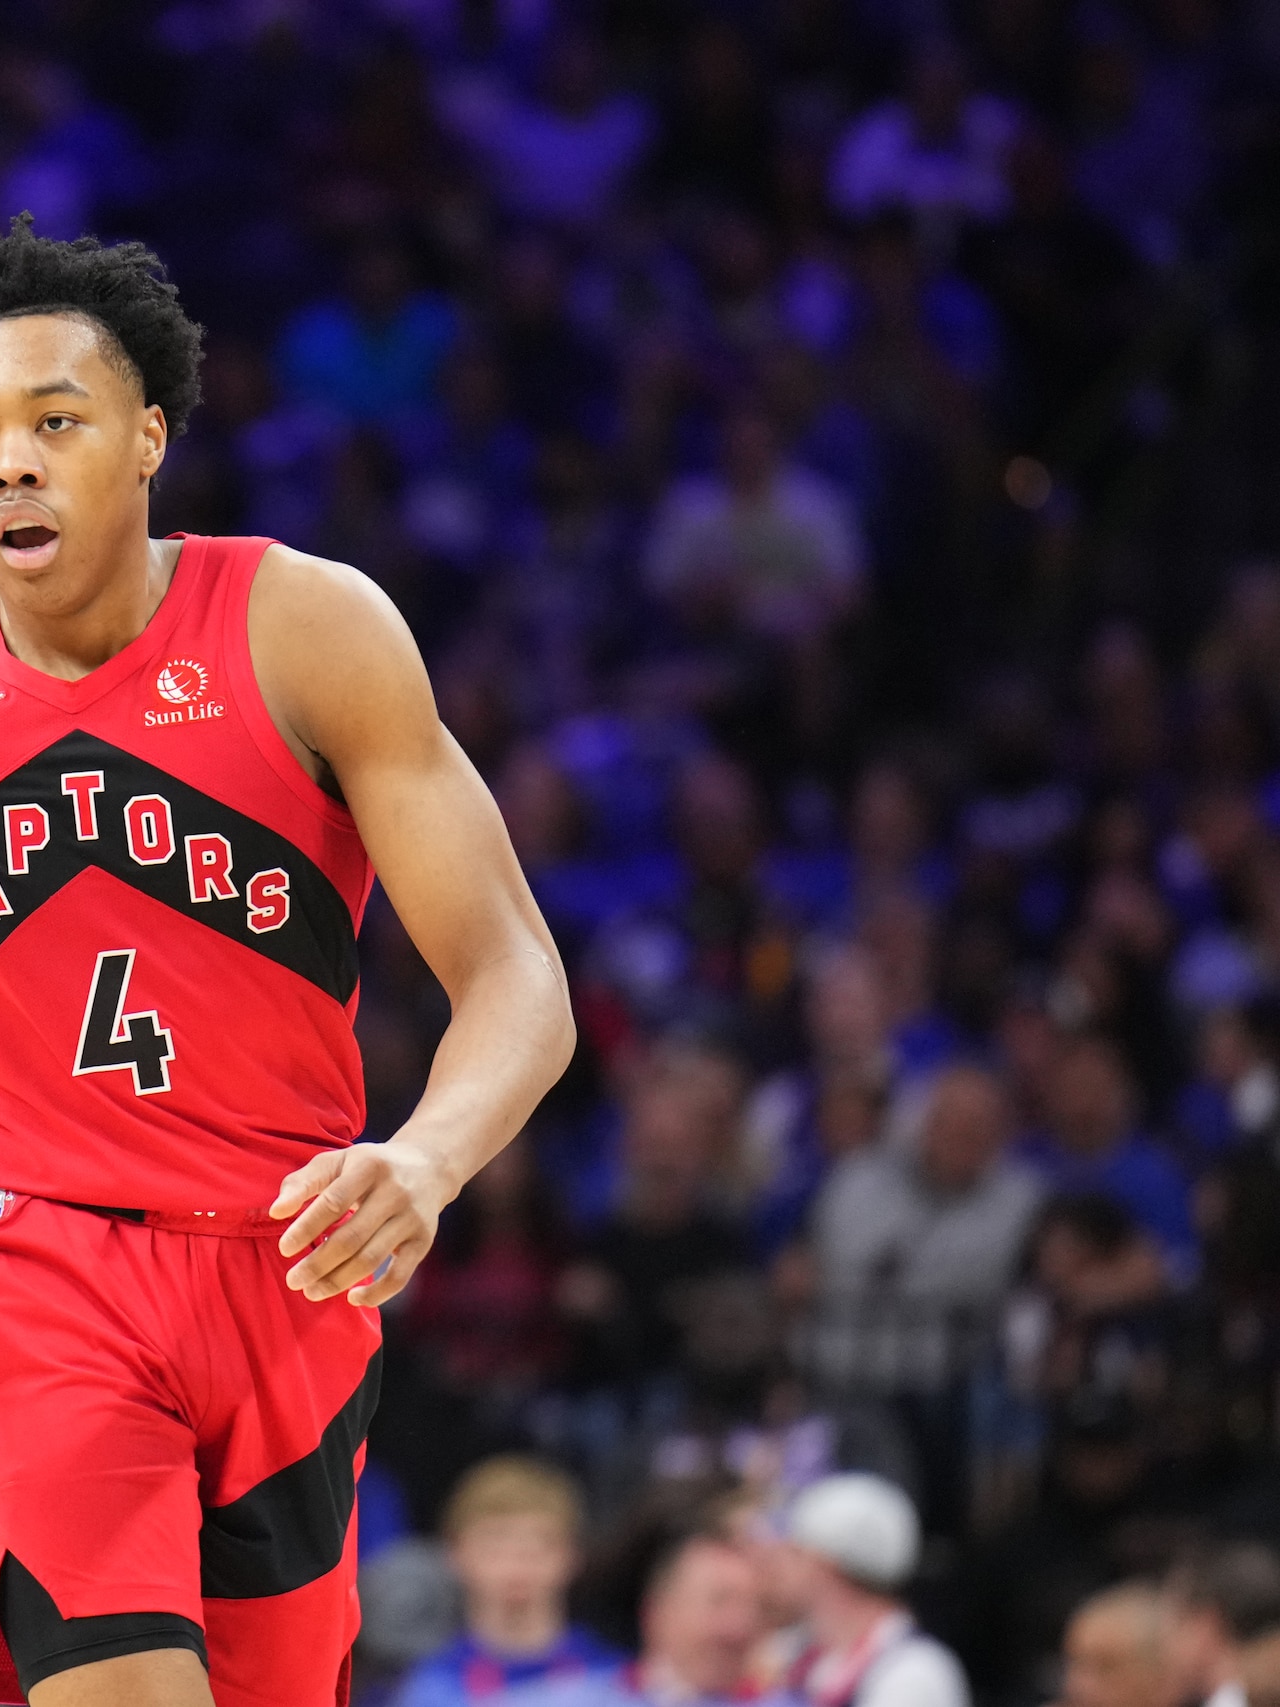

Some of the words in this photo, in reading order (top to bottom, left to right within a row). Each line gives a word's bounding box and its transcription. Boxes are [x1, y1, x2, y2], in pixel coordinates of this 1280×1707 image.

[144, 710, 183, 727] Sun
[187, 701, 224, 720] Life
[72, 949, 176, 1097] 4
